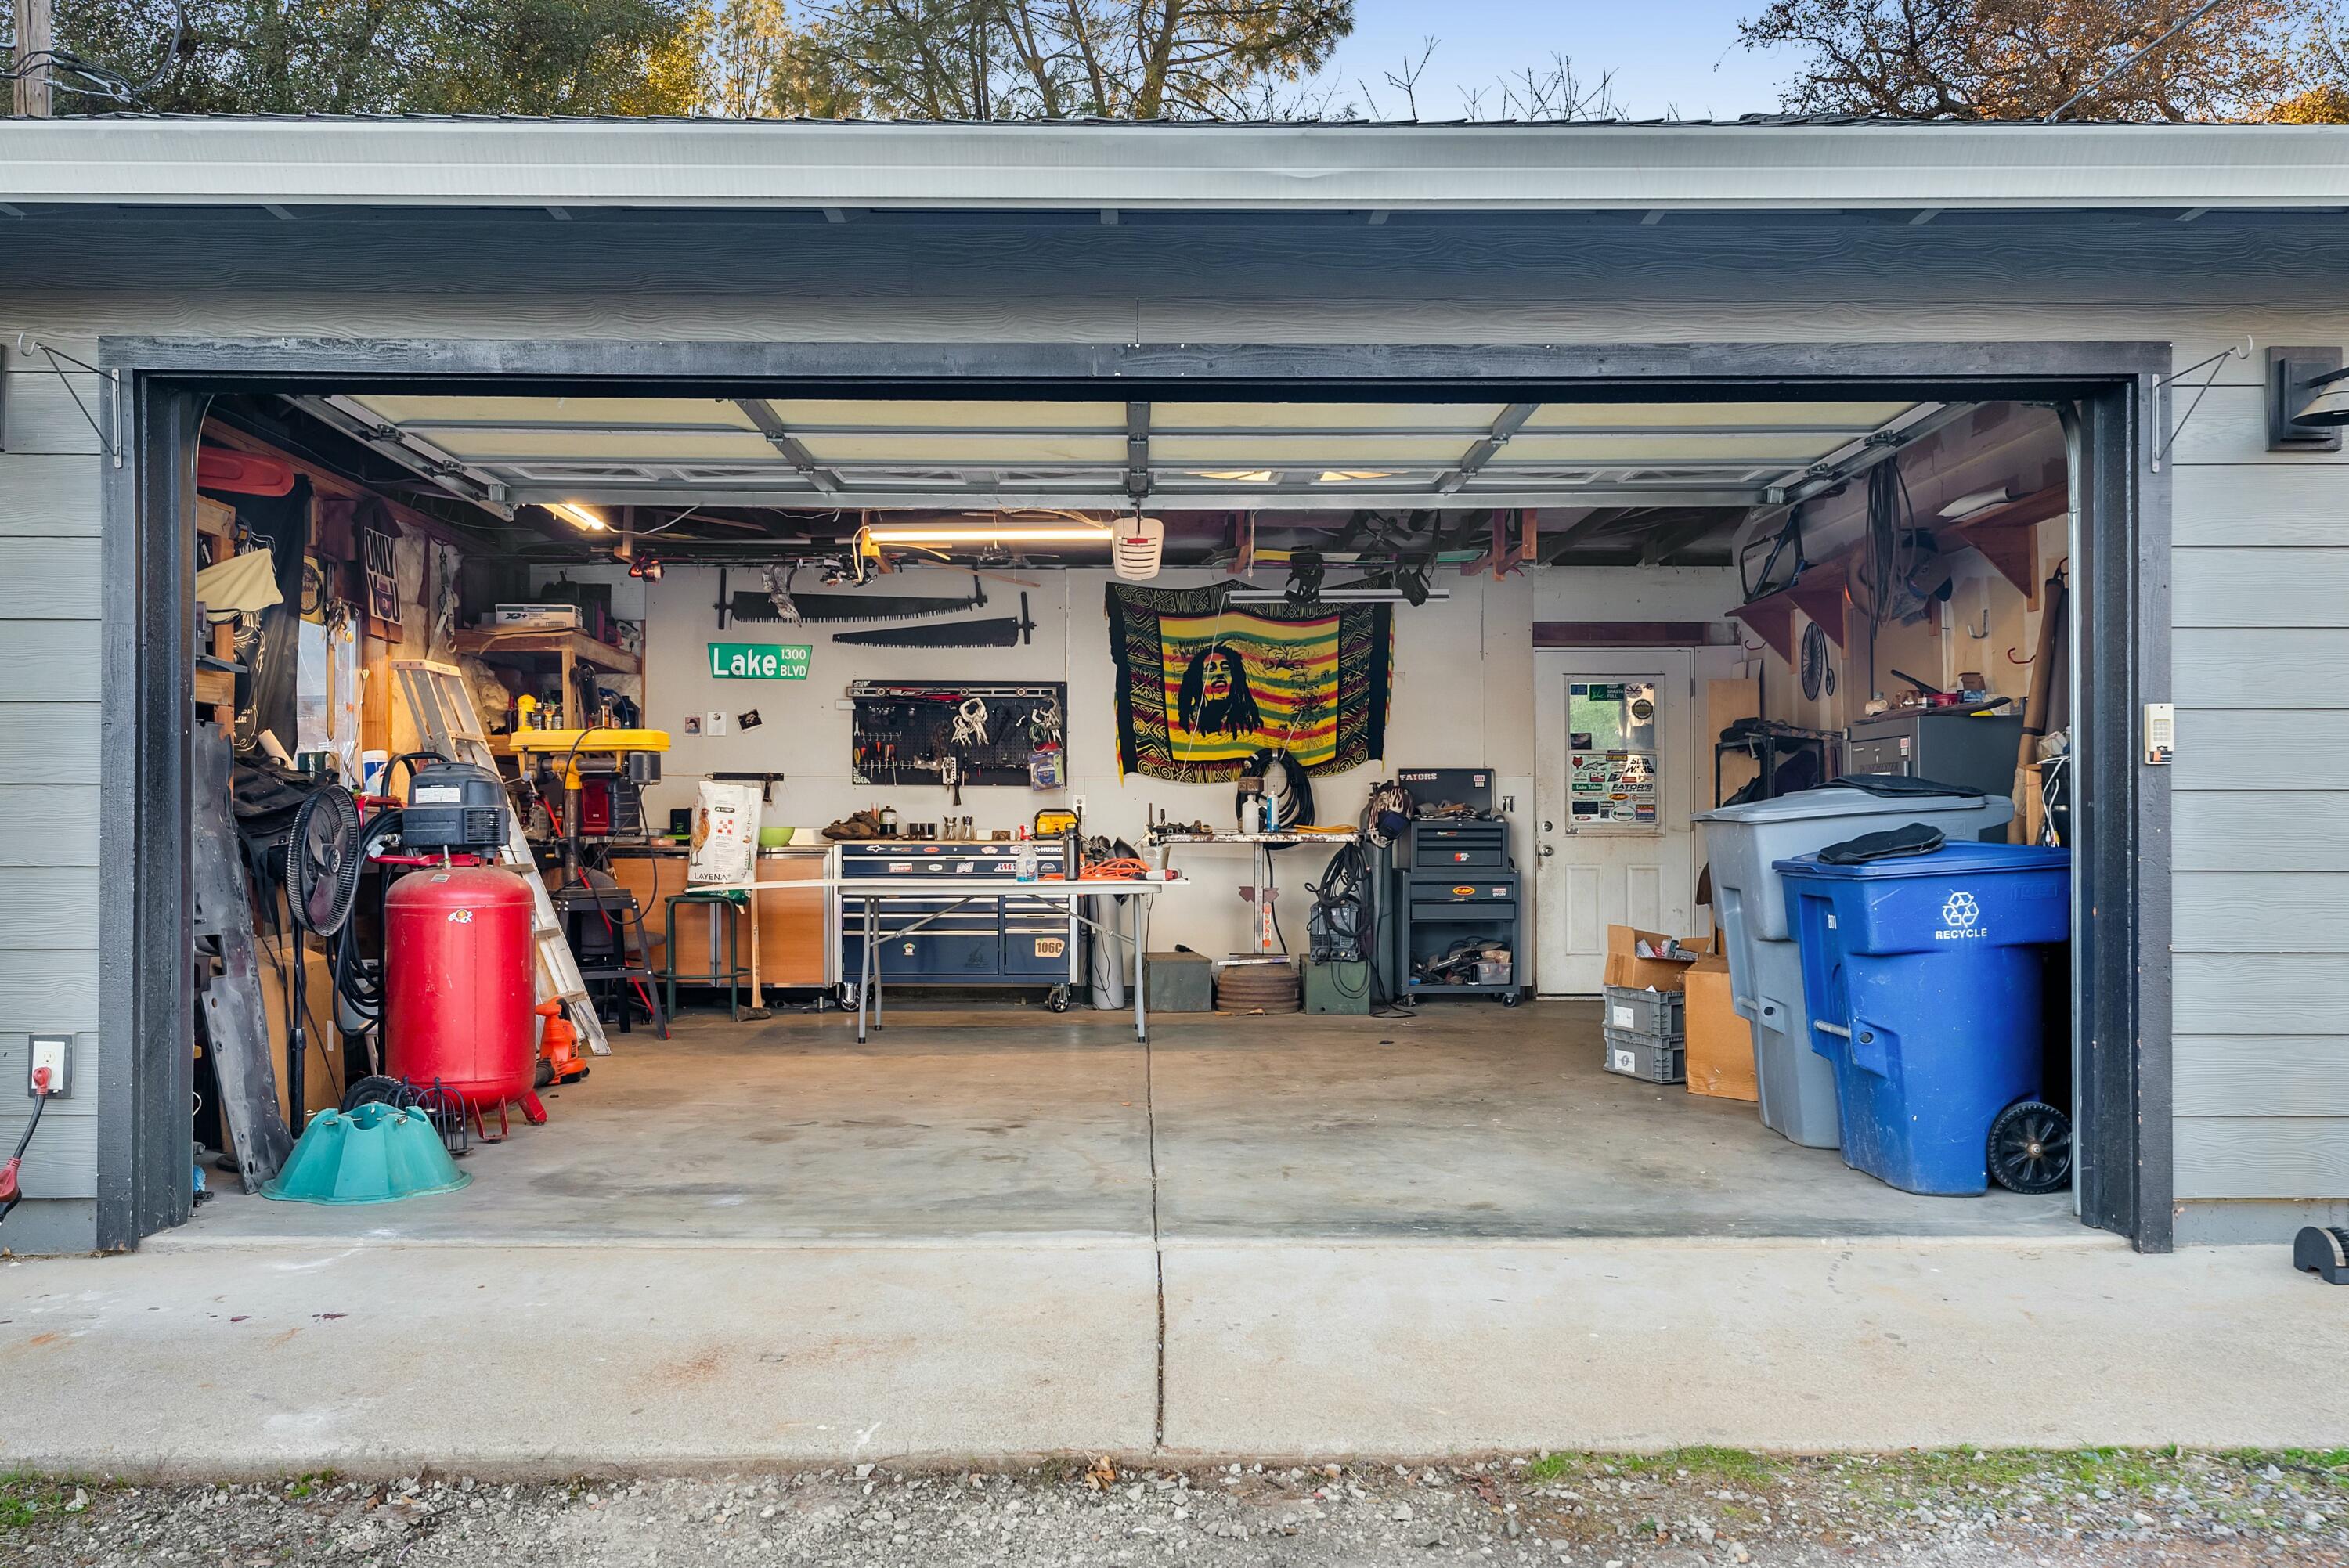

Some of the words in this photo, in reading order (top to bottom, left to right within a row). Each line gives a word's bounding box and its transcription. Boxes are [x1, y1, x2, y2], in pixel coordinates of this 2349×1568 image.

[365, 528, 394, 579] ONLY
[368, 572, 400, 623] YOU
[781, 649, 806, 659] 1300
[713, 648, 778, 676] Lake
[780, 665, 806, 676] BLVD
[1935, 928, 1988, 940] RECYCLE
[1037, 942, 1062, 953] 106C
